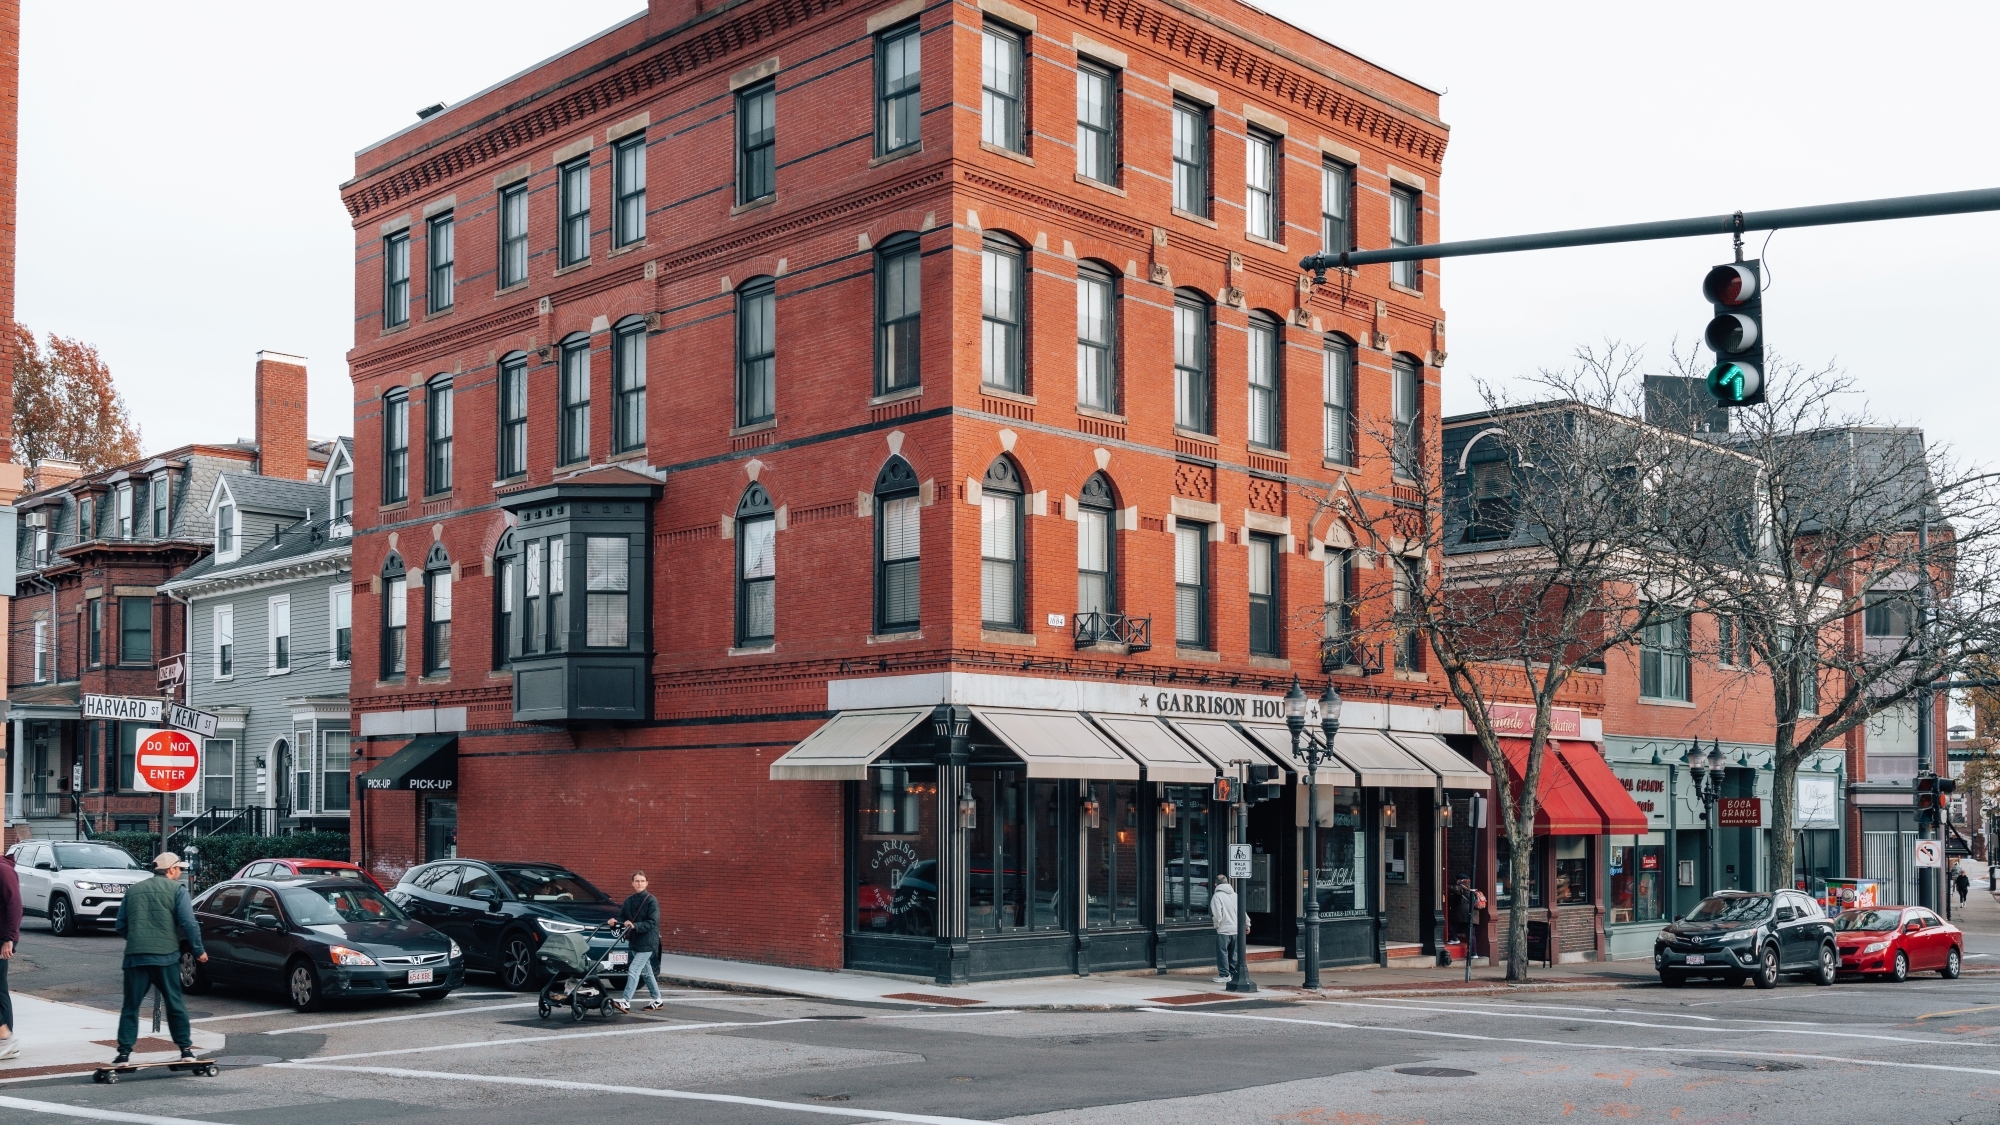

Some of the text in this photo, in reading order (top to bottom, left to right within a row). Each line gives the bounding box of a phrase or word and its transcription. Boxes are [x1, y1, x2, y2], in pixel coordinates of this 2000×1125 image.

[160, 664, 177, 680] ONE WAY
[87, 696, 160, 719] HARVARD ST
[1157, 692, 1286, 719] GARRISON HOU
[174, 707, 212, 730] KENT ST
[1529, 712, 1576, 733] Colatier
[147, 741, 191, 752] DO NOT
[150, 769, 185, 780] ENTER
[367, 779, 391, 789] PICK-UP
[409, 779, 453, 789] PICK-UP
[1619, 778, 1665, 793] OCA GRANDE
[1727, 799, 1751, 809] BOCA
[1721, 809, 1758, 818] GRANDE
[871, 839, 920, 869] GARRISON
[884, 854, 907, 867] HOUSE
[1337, 867, 1355, 886] Club
[874, 888, 919, 914] BROOKLINE VILLAGE
